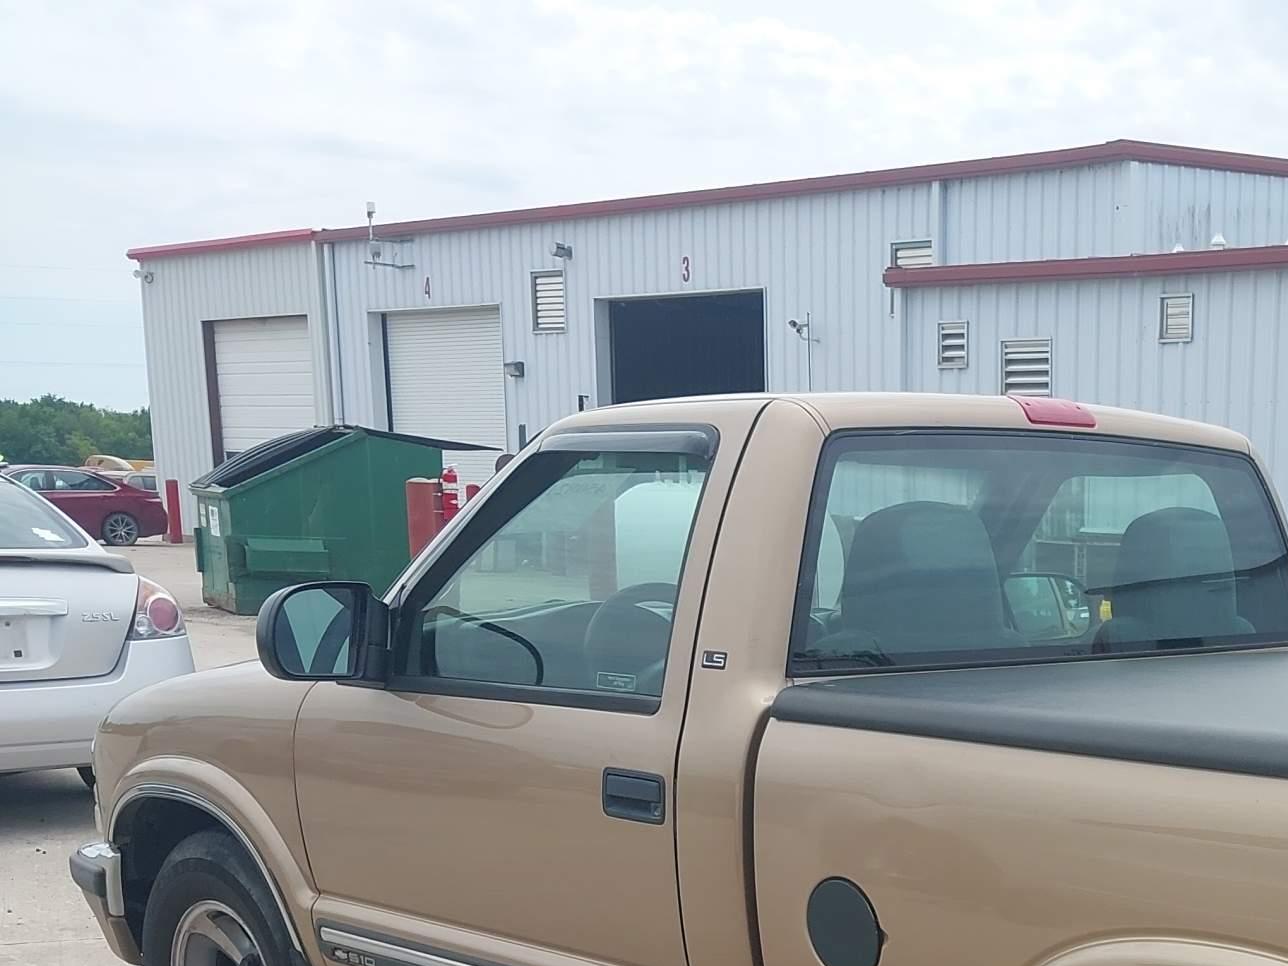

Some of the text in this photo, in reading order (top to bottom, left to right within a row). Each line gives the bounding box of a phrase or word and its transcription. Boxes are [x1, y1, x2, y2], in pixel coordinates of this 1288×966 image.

[682, 256, 690, 282] 3
[424, 276, 431, 299] 4
[703, 652, 726, 667] LS
